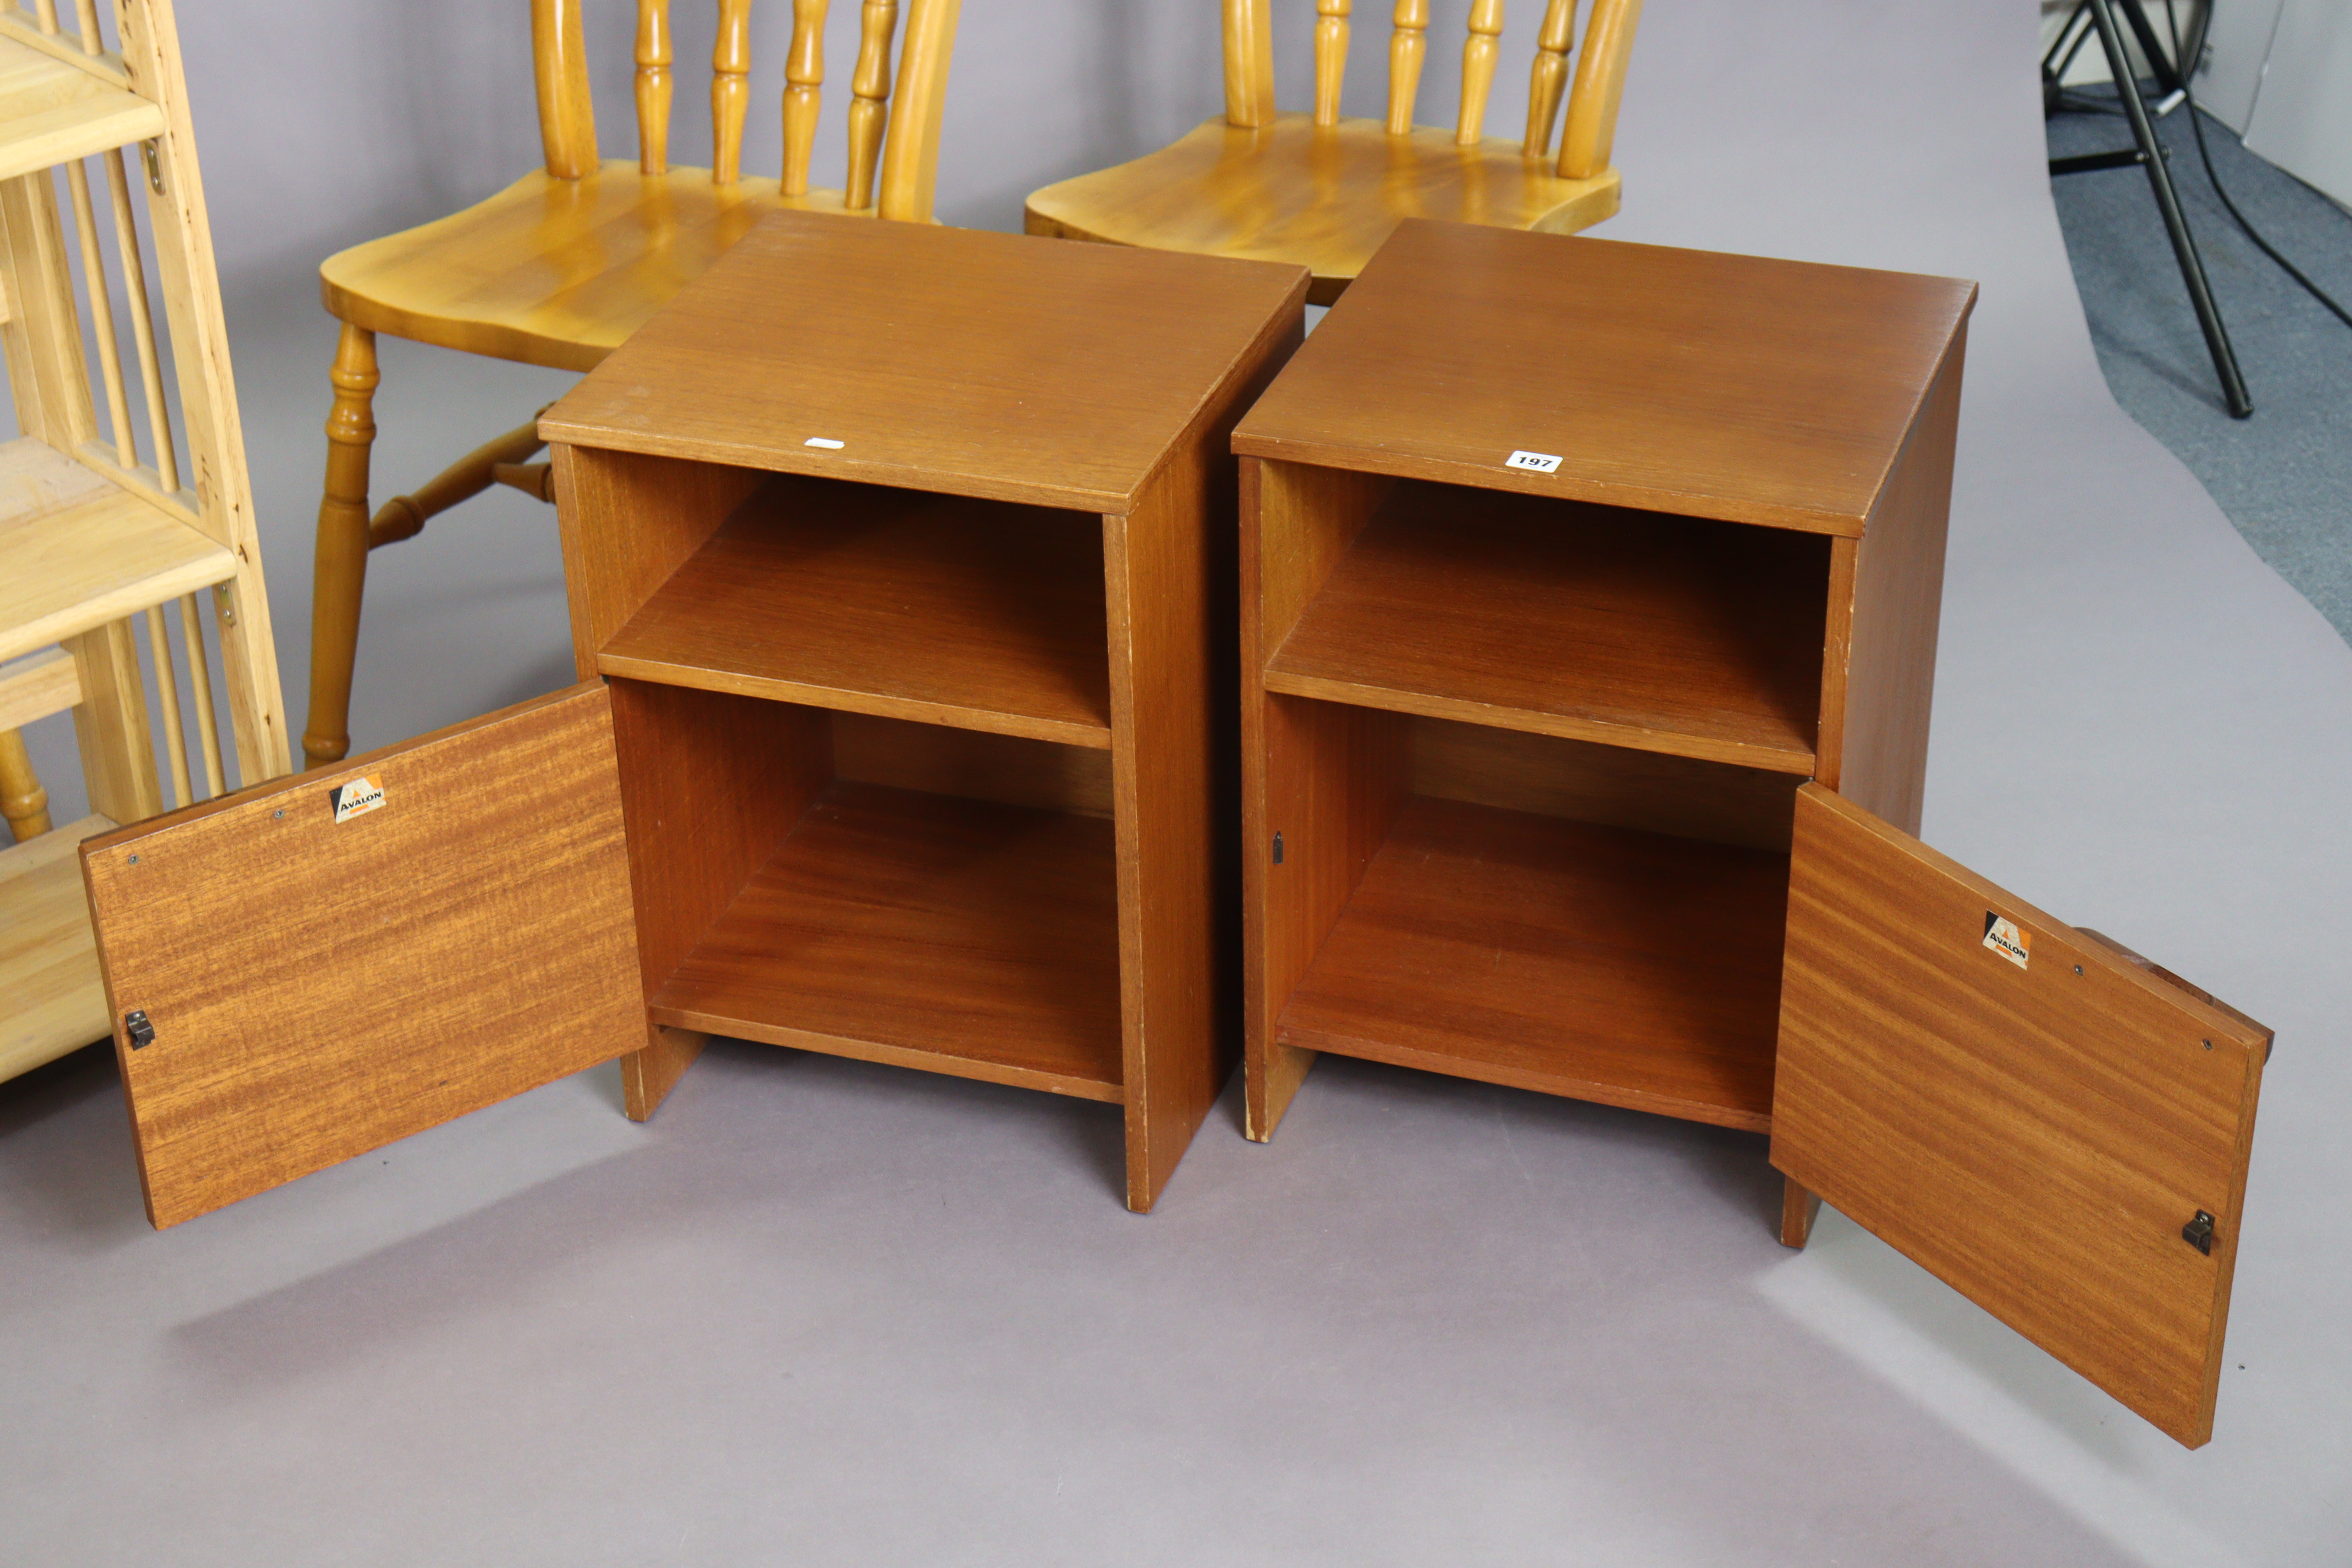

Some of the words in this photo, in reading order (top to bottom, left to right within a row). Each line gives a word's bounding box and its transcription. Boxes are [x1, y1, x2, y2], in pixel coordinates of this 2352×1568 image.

[1520, 456, 1553, 467] 197
[341, 792, 381, 812] AVALON
[1990, 933, 2026, 958] AVALON
